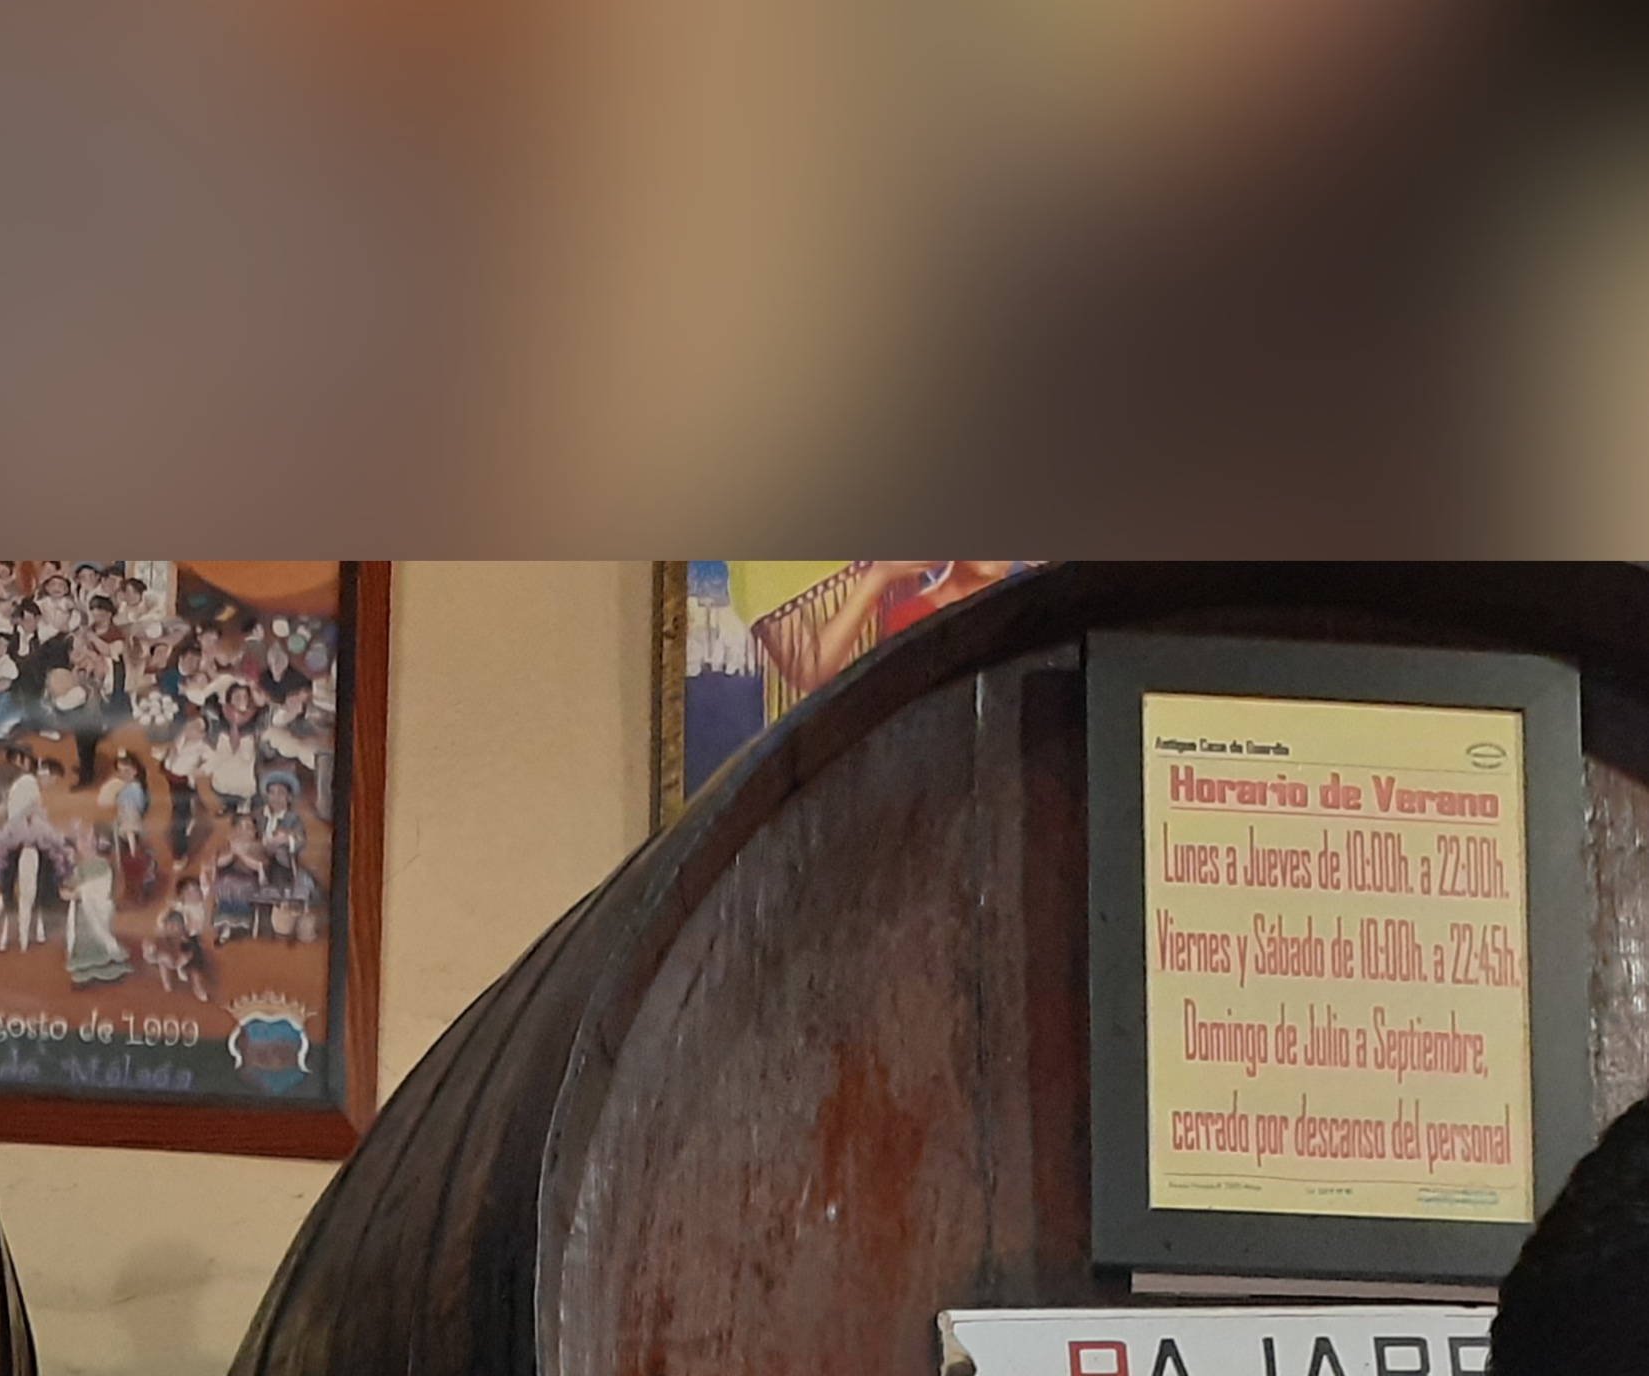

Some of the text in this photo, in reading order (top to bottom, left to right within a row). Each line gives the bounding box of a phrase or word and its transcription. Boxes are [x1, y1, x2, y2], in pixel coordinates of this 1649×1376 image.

[1170, 764, 1499, 818] Horario de Verano
[1163, 822, 1510, 899] Lunes a Jueves de 10:00h. a 22:00h.
[1156, 908, 1231, 974] Viernes
[1236, 934, 1248, 989] y
[1253, 912, 1325, 978] Sábado
[1331, 916, 1354, 980] de
[1360, 918, 1428, 983] 10:00h.
[1434, 944, 1445, 983] a
[79, 1008, 114, 1044] de
[121, 1012, 199, 1048] 1999
[1184, 998, 1488, 1084] Domingo de Julio a Septiembre,
[1171, 1090, 1512, 1175] cerrado por descanso del personal
